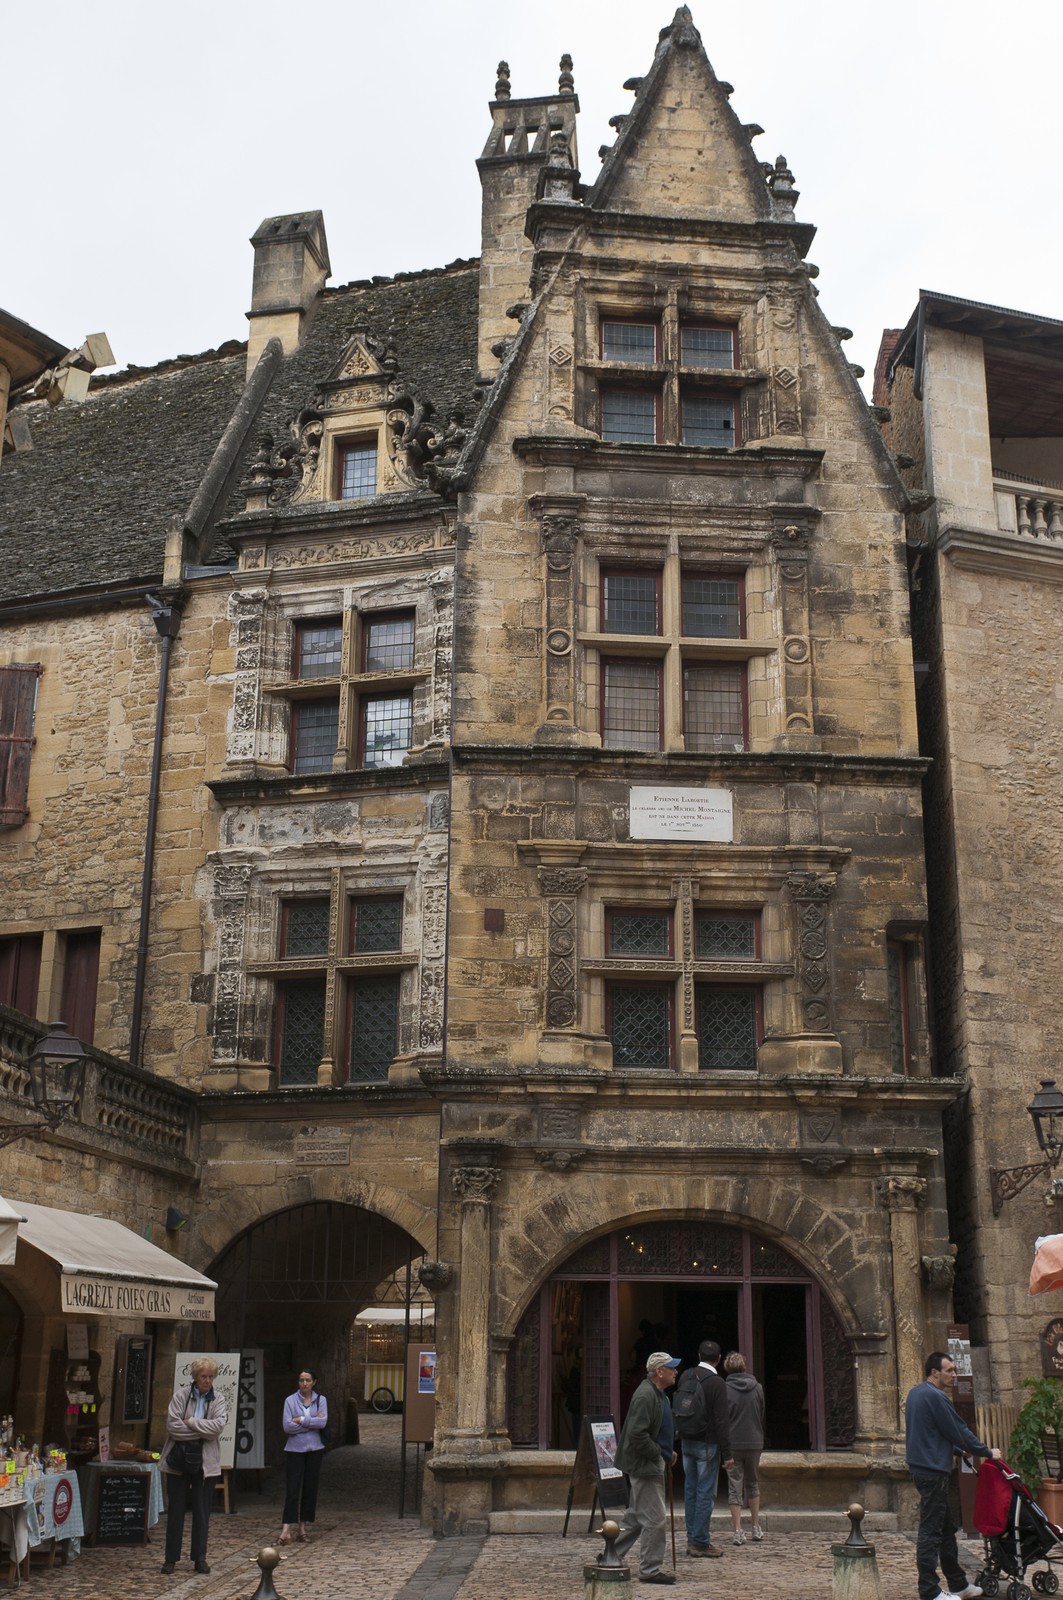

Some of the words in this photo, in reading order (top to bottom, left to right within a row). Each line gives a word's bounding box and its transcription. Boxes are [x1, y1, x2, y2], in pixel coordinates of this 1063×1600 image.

[653, 795, 680, 803] ETIENNE
[697, 806, 731, 814] MONTAIGNE
[65, 1281, 114, 1309] LAGRÈZE
[116, 1286, 145, 1312] FOIES
[146, 1289, 171, 1313] GRAS
[186, 1291, 205, 1305] Artisan
[180, 1304, 211, 1319] Conserveur
[237, 1356, 257, 1454] EXPO
